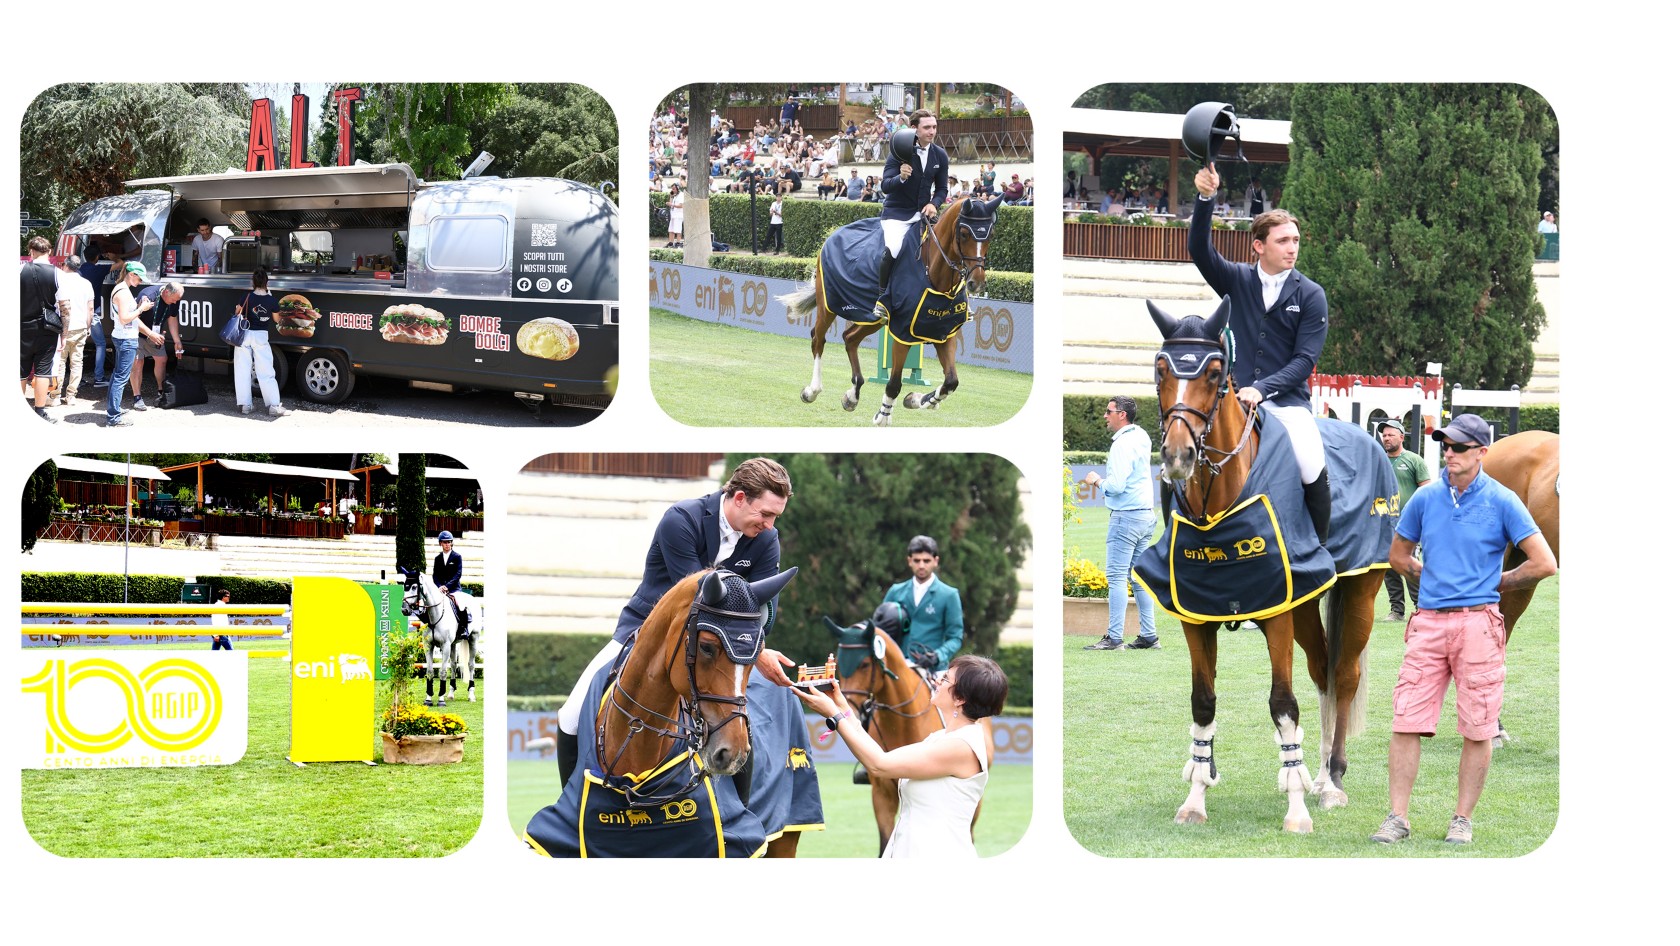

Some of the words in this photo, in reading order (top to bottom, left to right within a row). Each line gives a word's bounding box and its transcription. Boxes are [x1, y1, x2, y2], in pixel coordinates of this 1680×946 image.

[246, 87, 364, 172] ALT
[523, 252, 546, 261] SCOPRI
[547, 252, 565, 261] TUTTI
[524, 264, 546, 273] NOSTRI
[547, 264, 567, 274] STORE
[695, 277, 716, 311] eni
[178, 299, 213, 329] OAD
[329, 311, 373, 330] FOCACCE
[459, 315, 501, 333] BOMBE
[475, 333, 510, 351] DOLCI
[1184, 548, 1205, 560] eni
[380, 589, 390, 618] INTESA
[294, 656, 335, 679] eni
[152, 692, 198, 719] AGIP
[44, 757, 93, 767] CENTO
[99, 757, 135, 766] ANNI
[140, 756, 154, 766] DI
[161, 753, 222, 766] ENERGIA
[599, 811, 625, 824] eni
